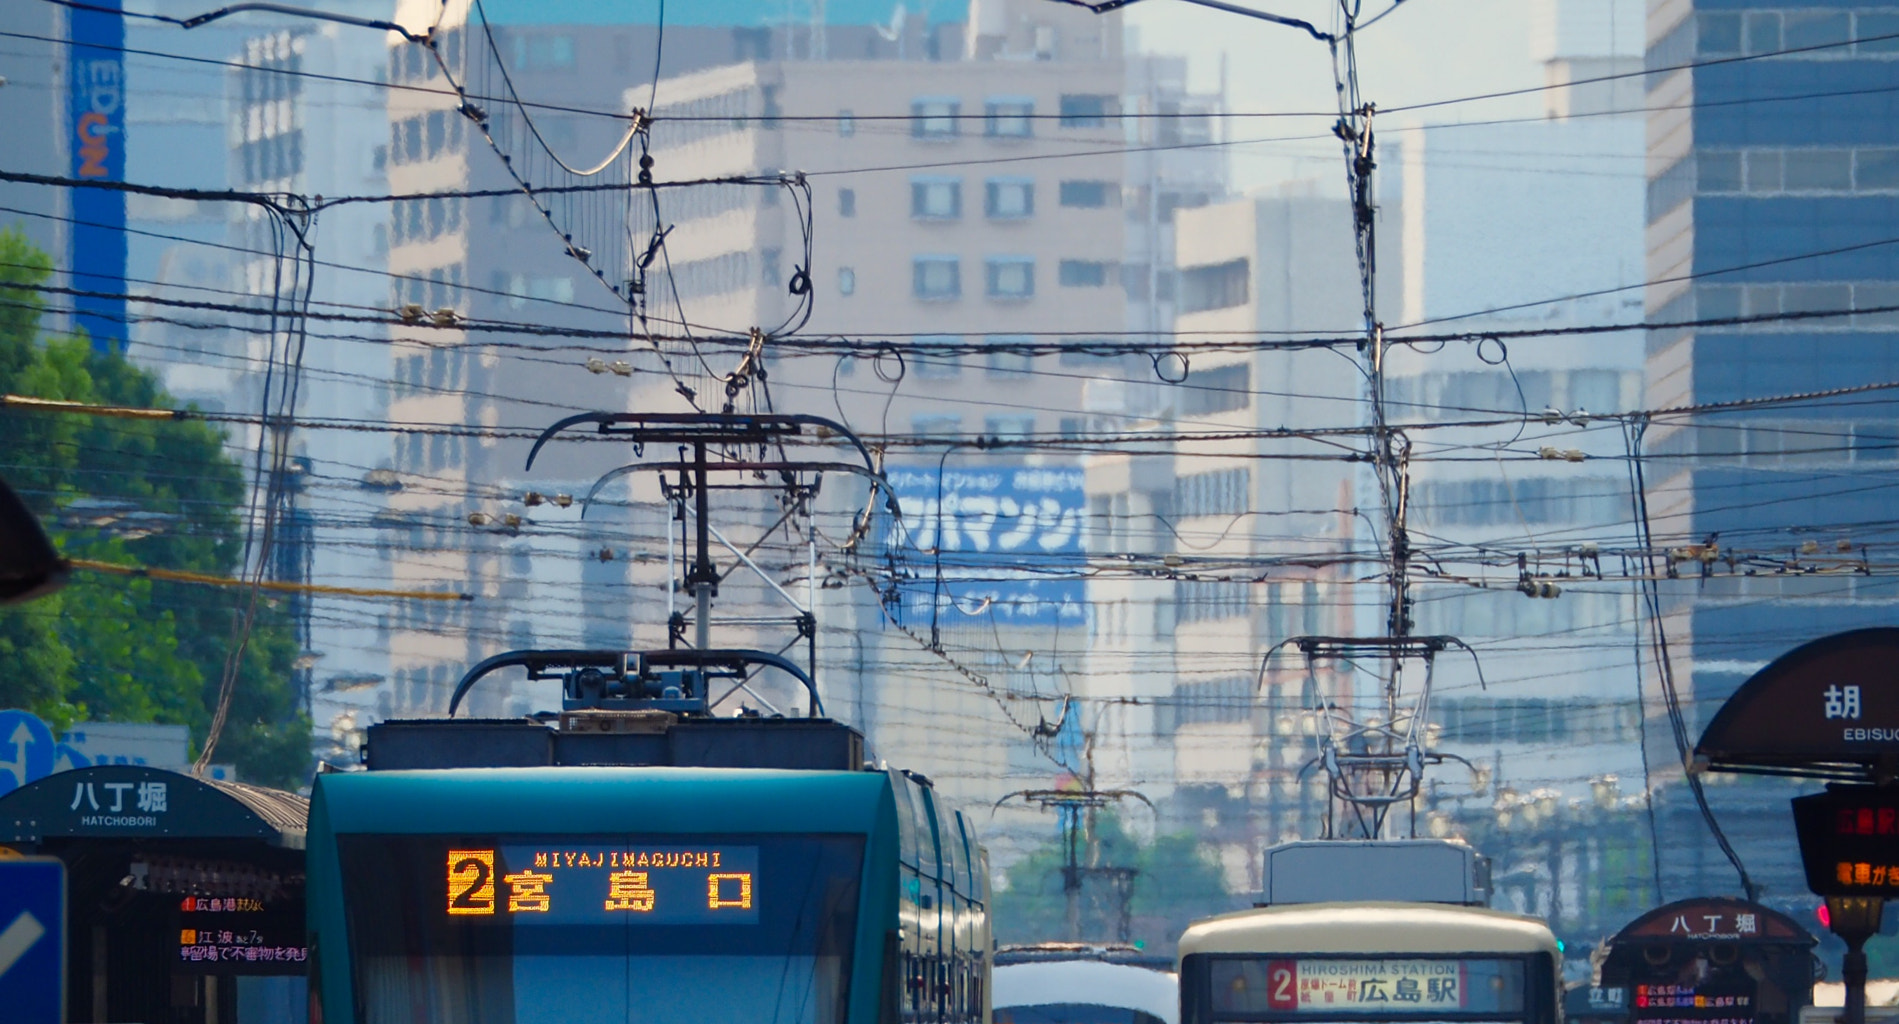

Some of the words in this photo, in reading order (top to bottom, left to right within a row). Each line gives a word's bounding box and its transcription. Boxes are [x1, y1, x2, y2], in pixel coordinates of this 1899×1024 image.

[77, 60, 120, 177] EDION
[1823, 684, 1861, 719] 胡
[70, 782, 167, 812] 八丁堀
[81, 815, 157, 827] HATCHOBORI
[534, 851, 722, 868] MIYAJIMAGUCHI
[451, 854, 492, 910] 2
[503, 869, 752, 911] 宮島口
[196, 898, 236, 911] 広島港
[1670, 913, 1756, 933] 八丁堀
[199, 929, 233, 944] 江波
[1301, 964, 1386, 976] HIROSHIMA
[1391, 964, 1456, 976] STATION
[1273, 969, 1291, 1001] 2
[1358, 976, 1457, 1003] 広島駅
